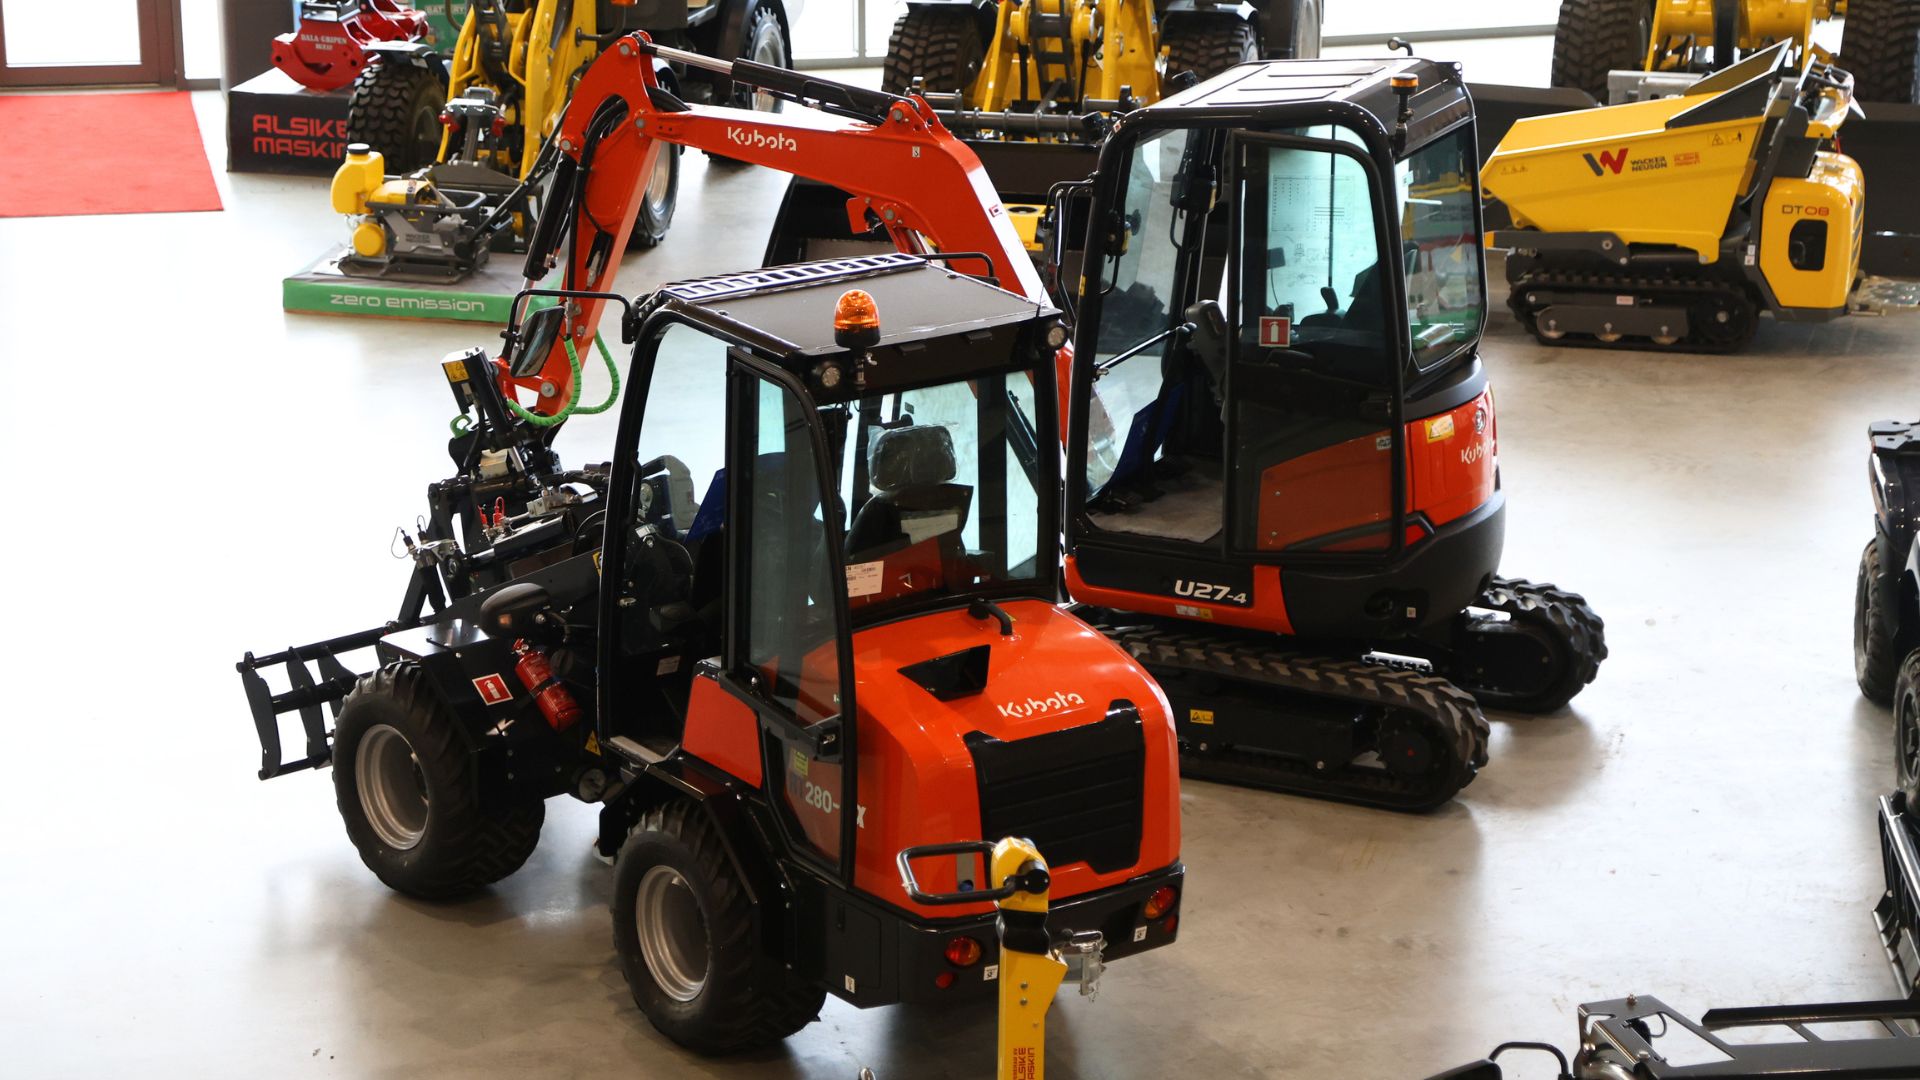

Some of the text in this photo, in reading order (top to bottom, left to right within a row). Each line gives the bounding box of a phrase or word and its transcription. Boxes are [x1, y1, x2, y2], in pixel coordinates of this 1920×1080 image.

[253, 114, 348, 138] ALSIKE
[728, 126, 797, 151] Kubota
[1630, 156, 1666, 165] WACKER
[1631, 162, 1667, 172] NEUSON
[330, 294, 485, 312] zero emission
[1174, 579, 1247, 604] U27-4
[997, 691, 1085, 718] Kubota
[1018, 1047, 1026, 1080] LSIKE
[1027, 1047, 1035, 1080] ASKIN
